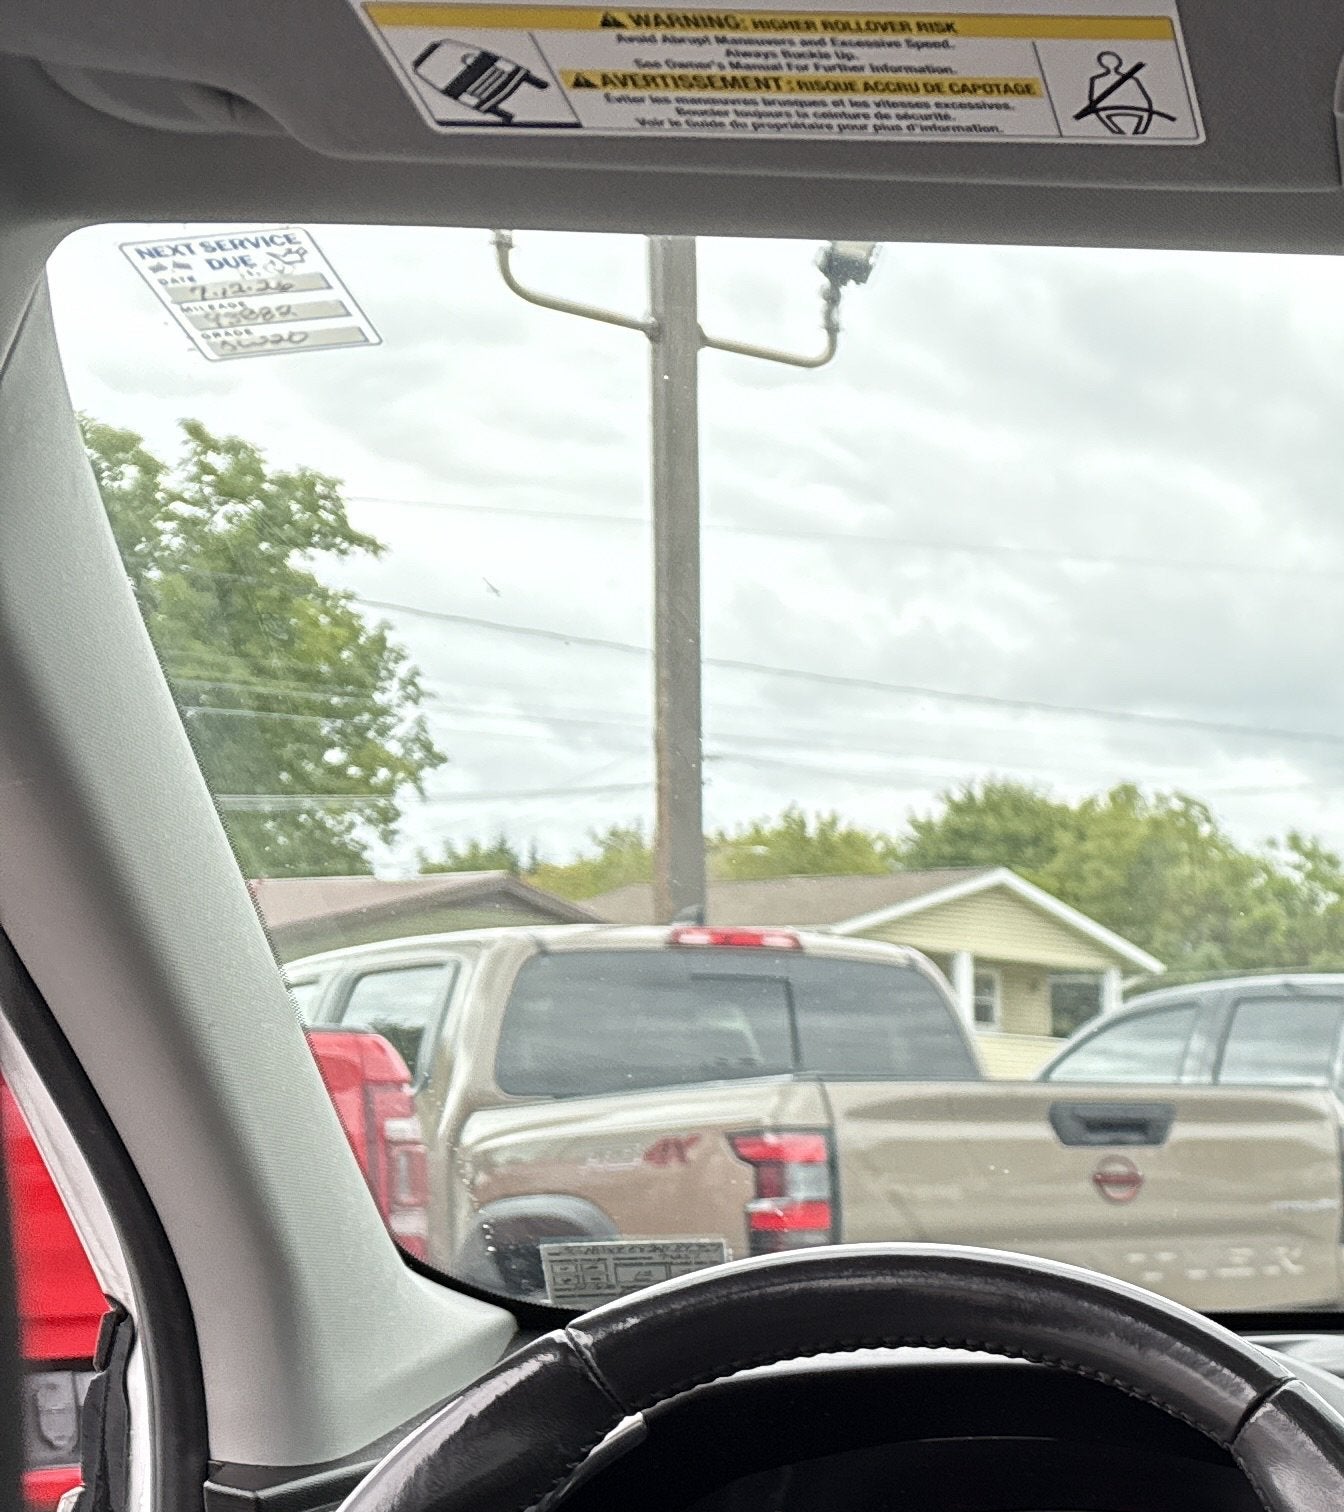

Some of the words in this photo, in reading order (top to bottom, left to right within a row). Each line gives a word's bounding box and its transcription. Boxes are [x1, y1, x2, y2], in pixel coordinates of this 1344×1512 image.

[628, 13, 746, 30] WARNING:
[135, 242, 197, 260] NEXT
[199, 233, 301, 253] SERVICE
[205, 254, 257, 271] DUE
